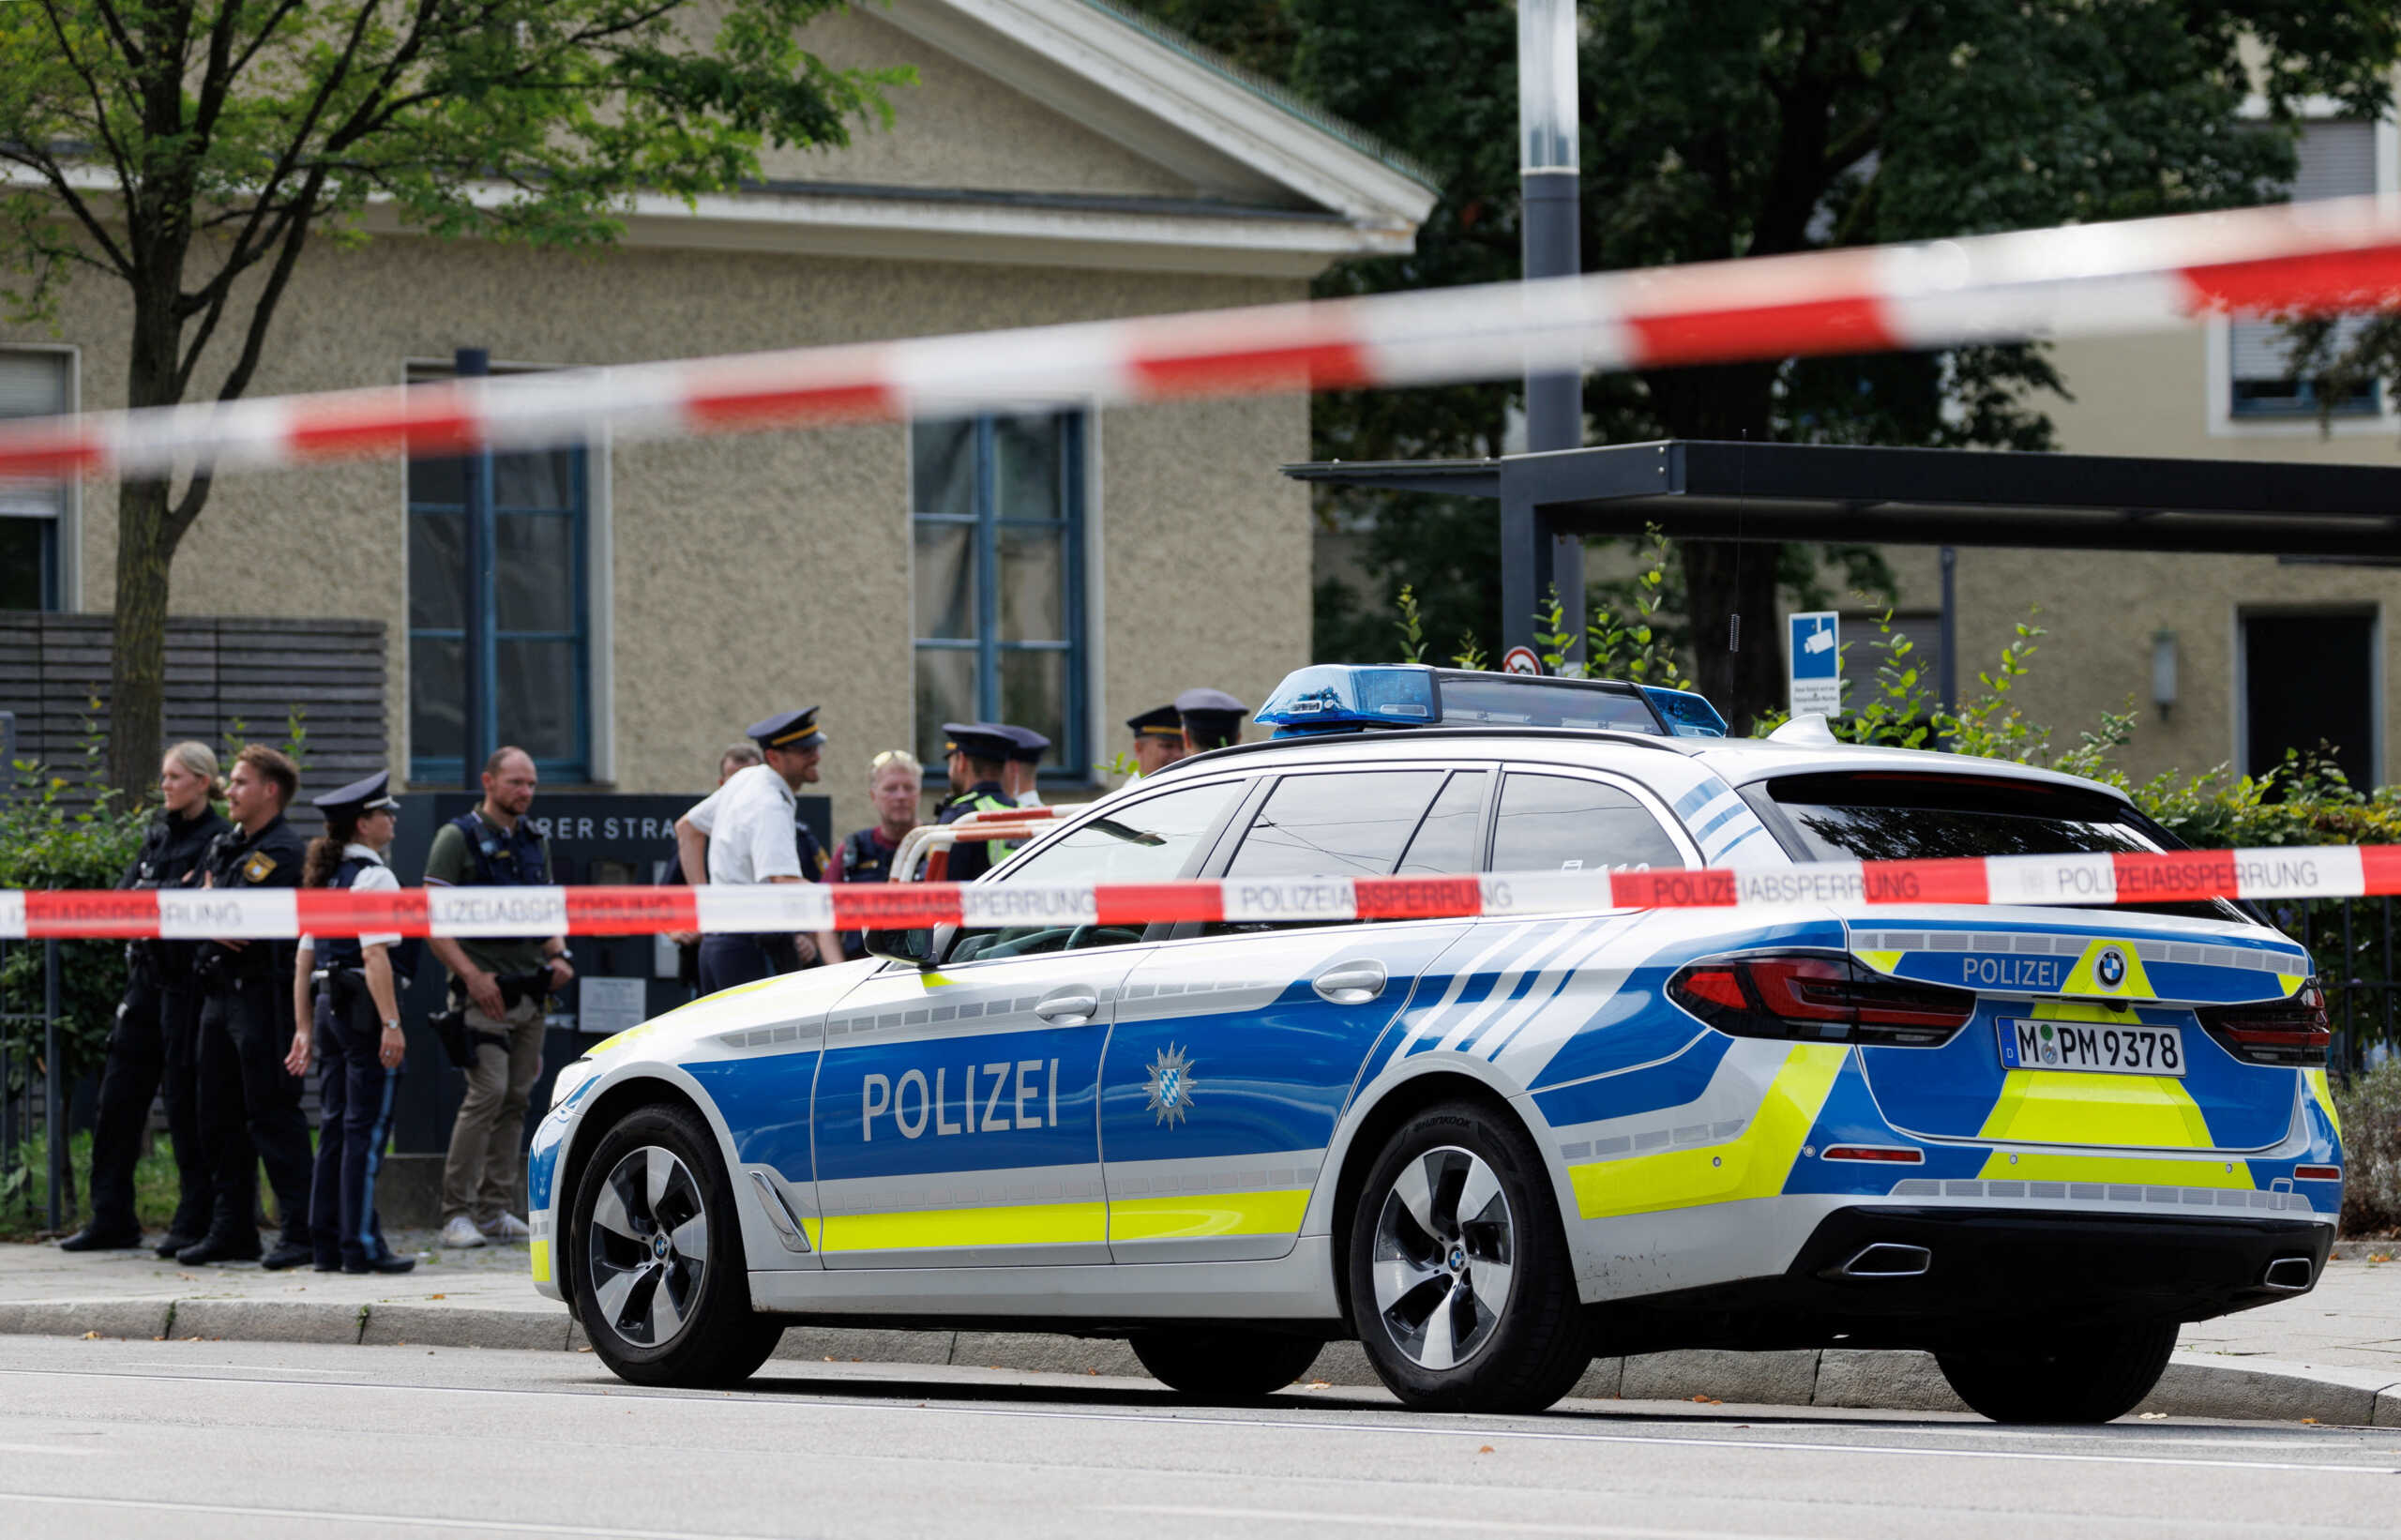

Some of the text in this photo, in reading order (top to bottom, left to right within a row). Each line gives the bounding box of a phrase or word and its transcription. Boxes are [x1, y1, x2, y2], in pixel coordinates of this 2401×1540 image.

[603, 817, 677, 839] STRA
[0, 902, 244, 926] IZEIABSPERRUNG
[821, 890, 1097, 918] POLIZEIABSPERRUNG
[1241, 880, 1513, 913] POLIZEIABSPERRUNG
[1653, 871, 1921, 905] POLIZEIABSPERRUNG
[2057, 860, 2318, 896] POLIZEIABSPERRUNG
[1963, 957, 2059, 987] POLIZEI
[2005, 1047, 2015, 1059] D
[2017, 1024, 2180, 1069] M PM 9378
[863, 1058, 1060, 1142] POLIZEI
